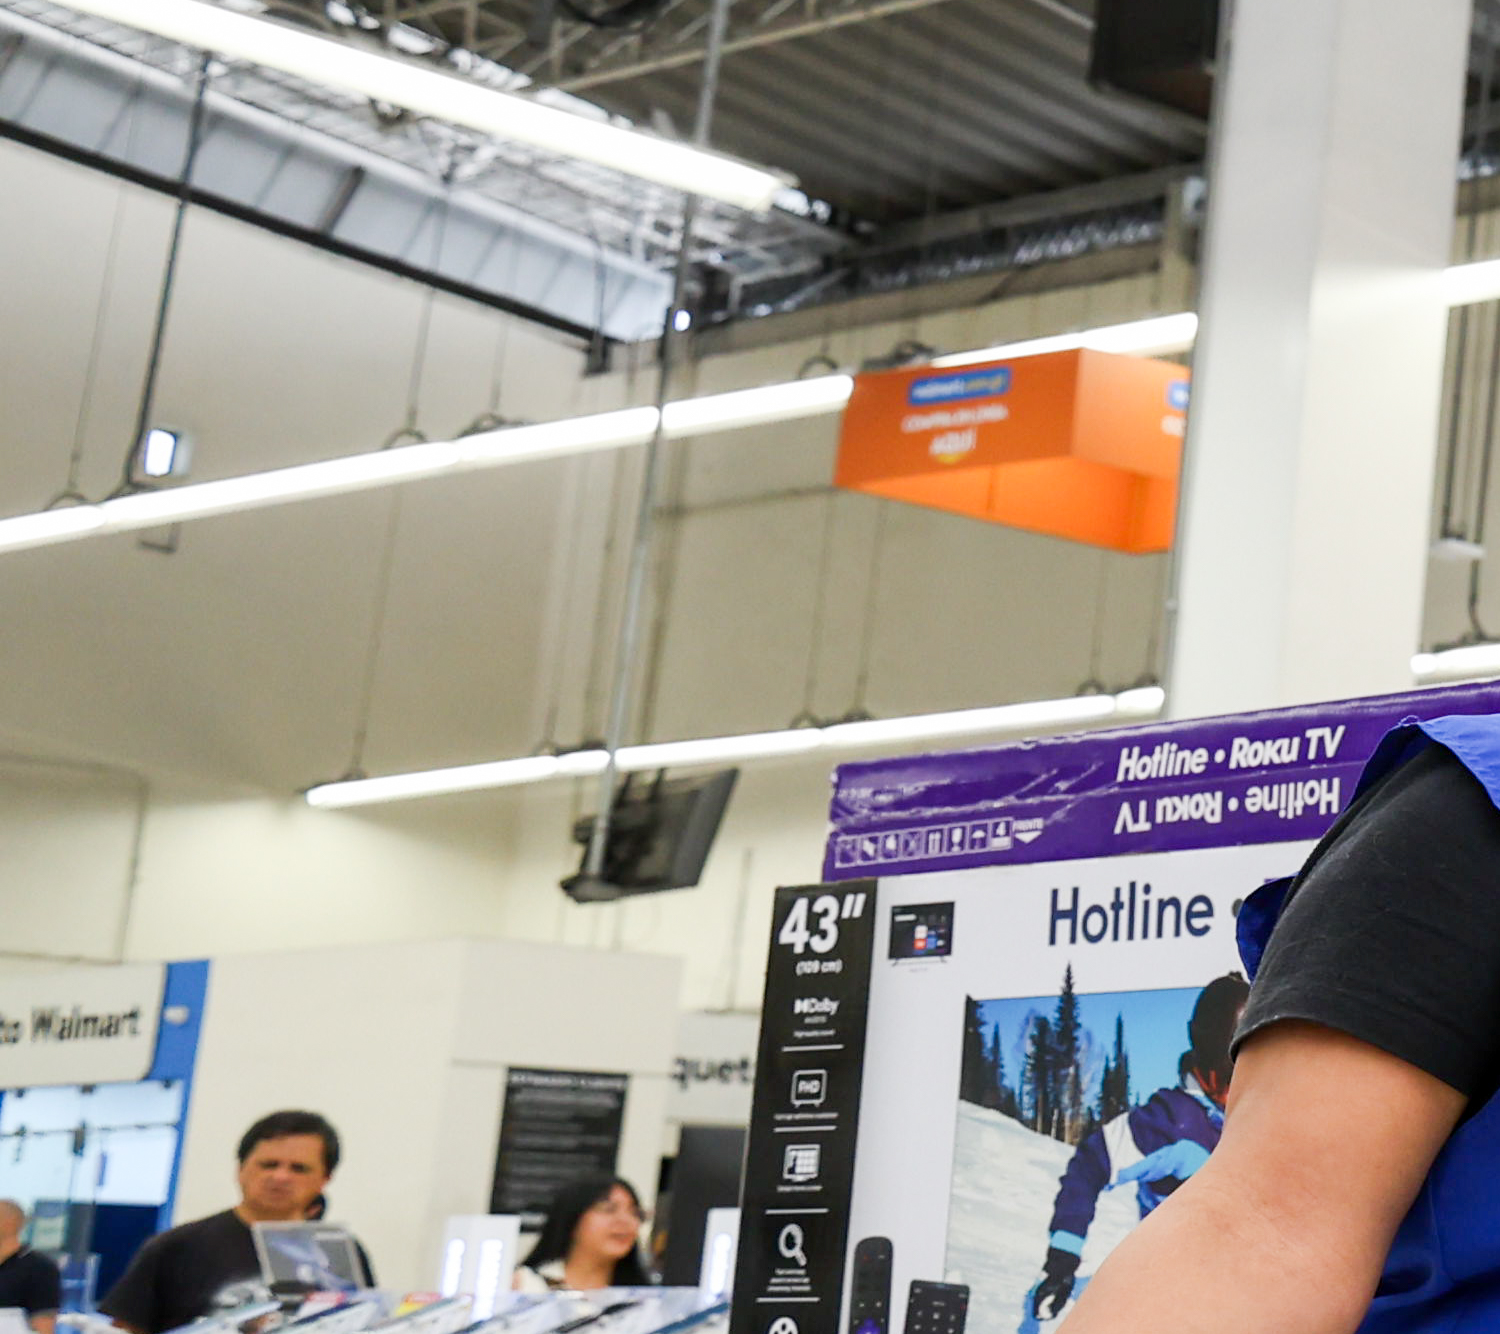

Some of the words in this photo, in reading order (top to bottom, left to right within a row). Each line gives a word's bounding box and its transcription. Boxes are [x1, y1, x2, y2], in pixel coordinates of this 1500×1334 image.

[1116, 741, 1207, 783] Hotline
[1229, 736, 1300, 770] Roku
[1305, 725, 1346, 760] TV
[1114, 800, 1153, 836] TV
[1154, 790, 1223, 825] Roku
[1244, 776, 1340, 819] Hotline
[1048, 881, 1214, 946] Hotline
